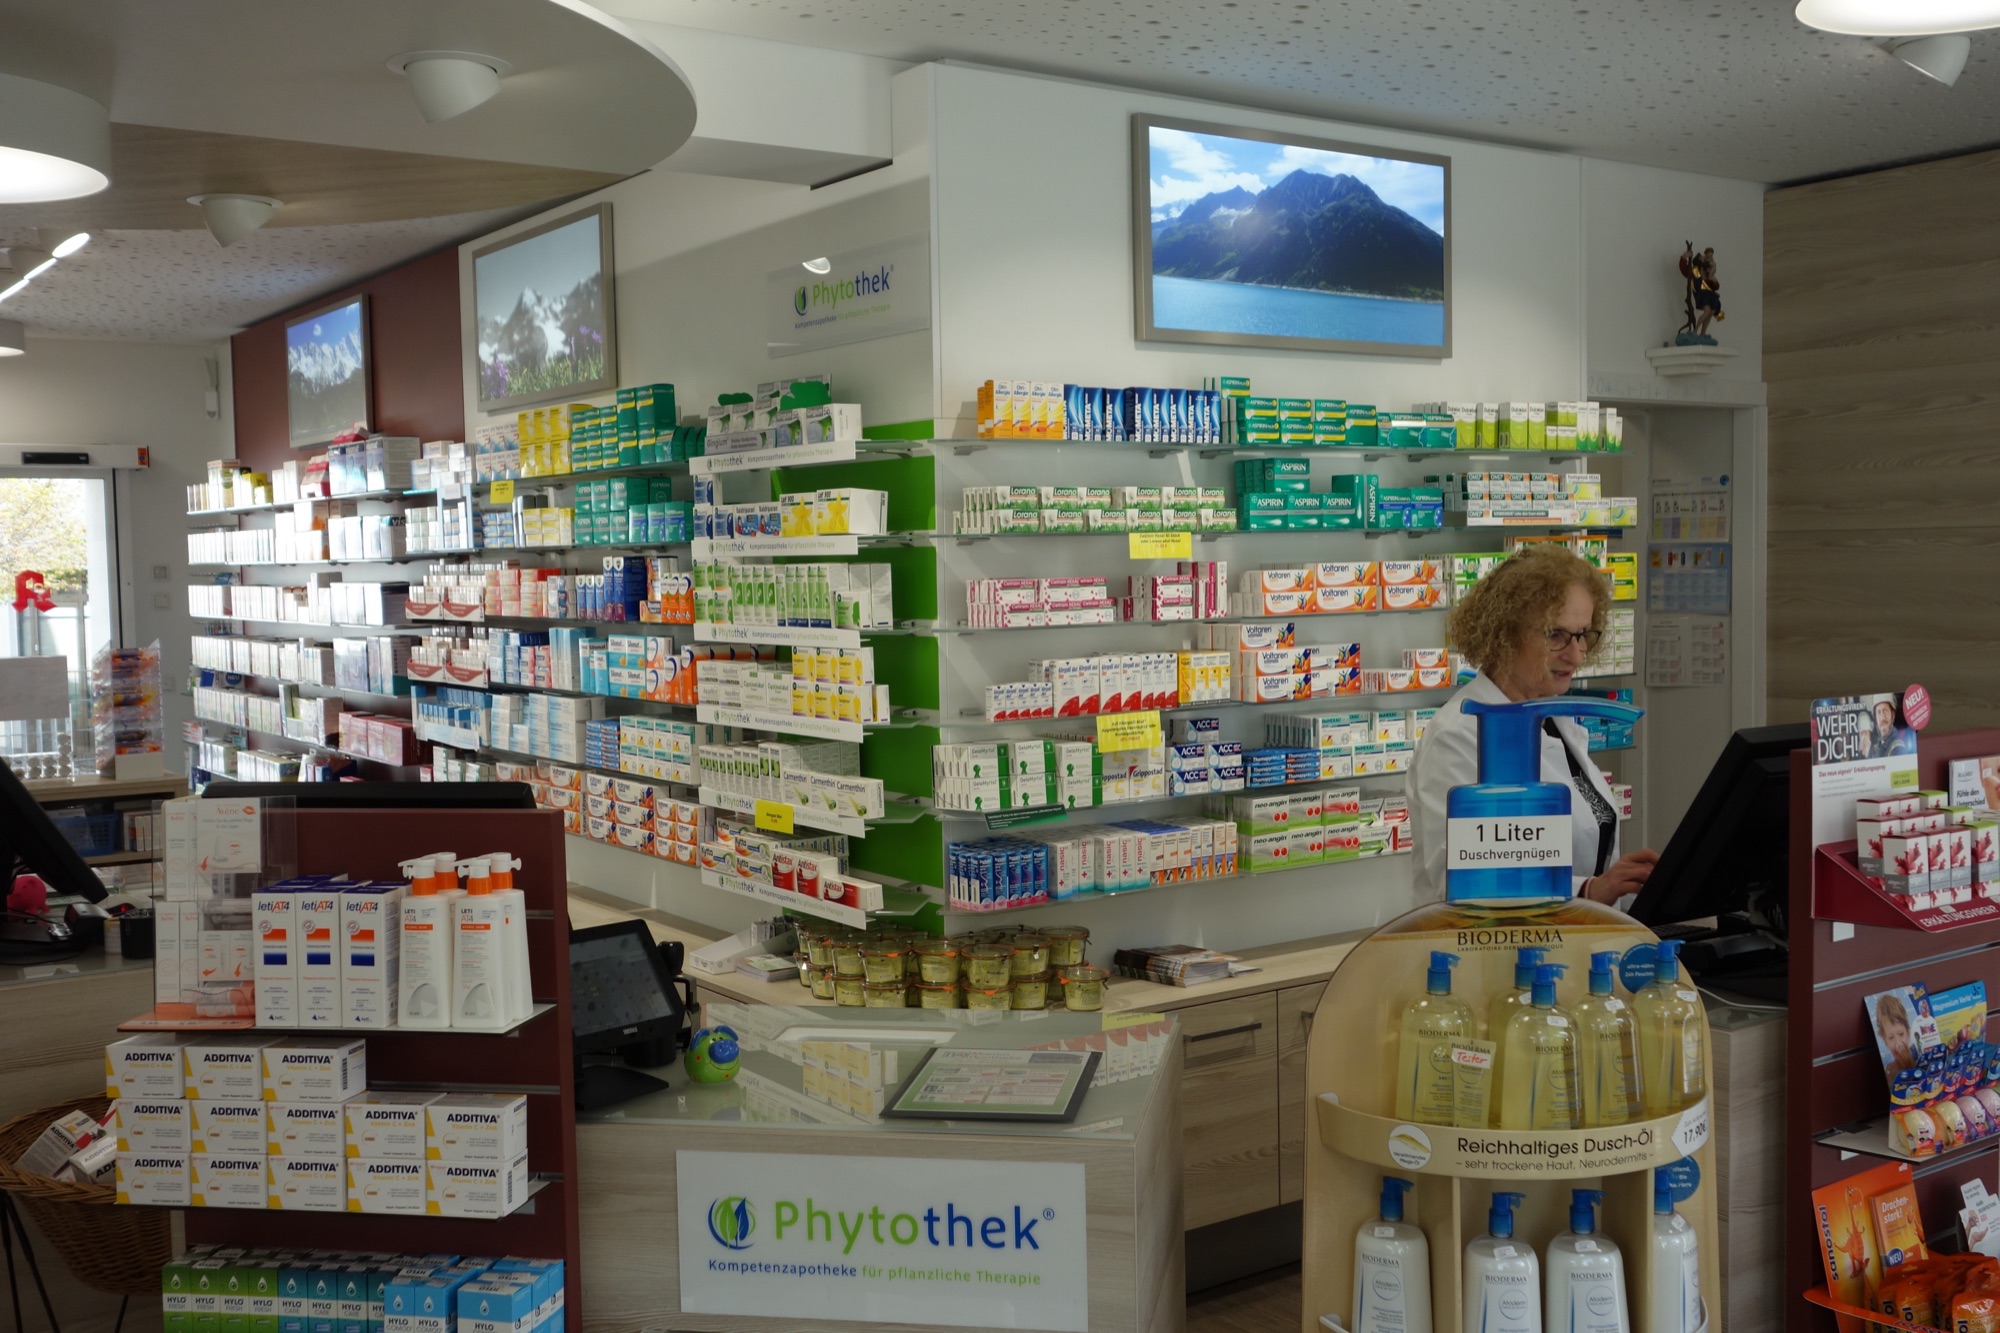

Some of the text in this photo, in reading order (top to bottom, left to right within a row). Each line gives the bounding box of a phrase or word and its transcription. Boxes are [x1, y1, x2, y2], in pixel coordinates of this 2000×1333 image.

[813, 266, 890, 309] Phytothek
[714, 455, 743, 468] Phytothek
[1280, 462, 1305, 471] ASPIRIN
[1011, 487, 1036, 496] Lorano
[1054, 487, 1077, 496] Lorano
[1087, 488, 1110, 496] Lorano
[1138, 487, 1160, 496] Lorano
[1175, 488, 1197, 497] Lorano
[1202, 489, 1224, 497] Lorano
[1256, 497, 1283, 506] ASPIRIN
[1293, 496, 1318, 505] ASPIRIN
[1325, 496, 1350, 505] ASPIRIN
[1368, 483, 1376, 521] ASPIRIN
[1013, 510, 1038, 519] Lorano
[1058, 510, 1082, 518] Lorano
[1102, 510, 1126, 519] Lorano
[715, 541, 745, 553] Phytothek
[1322, 563, 1349, 573] Voltaren
[1385, 561, 1411, 571] Voltaren
[1268, 572, 1291, 580] Voltaren
[1321, 587, 1349, 597] Voltaren
[1388, 586, 1414, 595] Voltaren
[1271, 593, 1294, 602] Voltaren
[718, 628, 748, 641] Phytothek
[1246, 626, 1272, 635] Voltaren
[1262, 652, 1289, 661] Voltaren
[1905, 687, 1925, 710] NEU!
[720, 712, 751, 724] Phytothek
[1197, 720, 1211, 729] ACC
[1816, 713, 1859, 738] WEHR
[1181, 746, 1196, 755] ACC
[1218, 744, 1233, 753] ACC
[1817, 735, 1859, 762] DICH!
[783, 771, 808, 783] Carmenthin
[1133, 767, 1163, 779] Grippostad
[1184, 771, 1199, 780] ACC
[1221, 768, 1236, 777] ACC
[810, 775, 835, 788] Carmenthin
[836, 781, 866, 793] Carmenthin
[1301, 794, 1321, 804] angin
[1341, 790, 1358, 800] angin
[1956, 789, 1980, 799] Fühle den
[723, 795, 753, 810] Phytothek
[1268, 800, 1288, 810] angin
[1956, 798, 1986, 808] Unterschied
[216, 806, 239, 816] Avène
[1303, 830, 1322, 840] angin
[1340, 826, 1358, 835] angin
[1477, 823, 1545, 843] 1 Liter
[1268, 835, 1287, 845] angin
[1459, 847, 1561, 863] Duschvergnügen
[772, 853, 793, 868] Antistax
[797, 859, 818, 874] Antistax
[725, 878, 755, 894] Phytothek
[824, 880, 842, 893] Antistax
[258, 900, 290, 913] letiAT4
[301, 900, 334, 913] letiAT4
[346, 901, 379, 914] letiAT4
[1458, 929, 1564, 946] BIODERMA
[1418, 1029, 1461, 1038] BIODERMA
[1451, 1043, 1491, 1055] BIODERMA
[125, 1053, 175, 1062] ADDITIVA
[204, 1054, 254, 1063] ADDITIVA
[282, 1054, 333, 1064] ADDITIVA
[1457, 1051, 1488, 1065] Tester
[134, 1105, 183, 1115] ADDITIVA
[210, 1107, 260, 1117] ADDITIVA
[287, 1109, 338, 1119] ADDITIVA
[366, 1110, 418, 1121] ADDITIVA
[447, 1114, 501, 1124] ADDITIVA
[1457, 1129, 1654, 1157] Reichhaltiges Dusch-Öl
[1465, 1160, 1489, 1170] sehr
[1491, 1161, 1544, 1172] trockene
[1579, 1152, 1648, 1169] Neurodermitis
[1881, 1195, 1909, 1212] Drachen-
[1883, 1209, 1904, 1225] stark!
[774, 1198, 1055, 1255] Phytothek®
[1818, 1204, 1840, 1283] sanostol
[1362, 1253, 1400, 1267] BIODERMA
[1888, 1253, 1903, 1267] NEU
[708, 1259, 1041, 1287] Kompetenzapotheke für pflanzliche Therapie
[1571, 1272, 1613, 1281] BIODERMA
[1485, 1274, 1528, 1285] BIODERMA
[166, 1296, 186, 1304] HYLO
[195, 1296, 215, 1304] HYLO
[224, 1297, 243, 1305] HYLO
[253, 1297, 272, 1305] HYLO
[282, 1300, 302, 1308] HYLO
[312, 1302, 331, 1310] HYLO
[341, 1303, 361, 1311] HYLO
[388, 1317, 409, 1326] HYLO
[418, 1319, 439, 1327] HYLO
